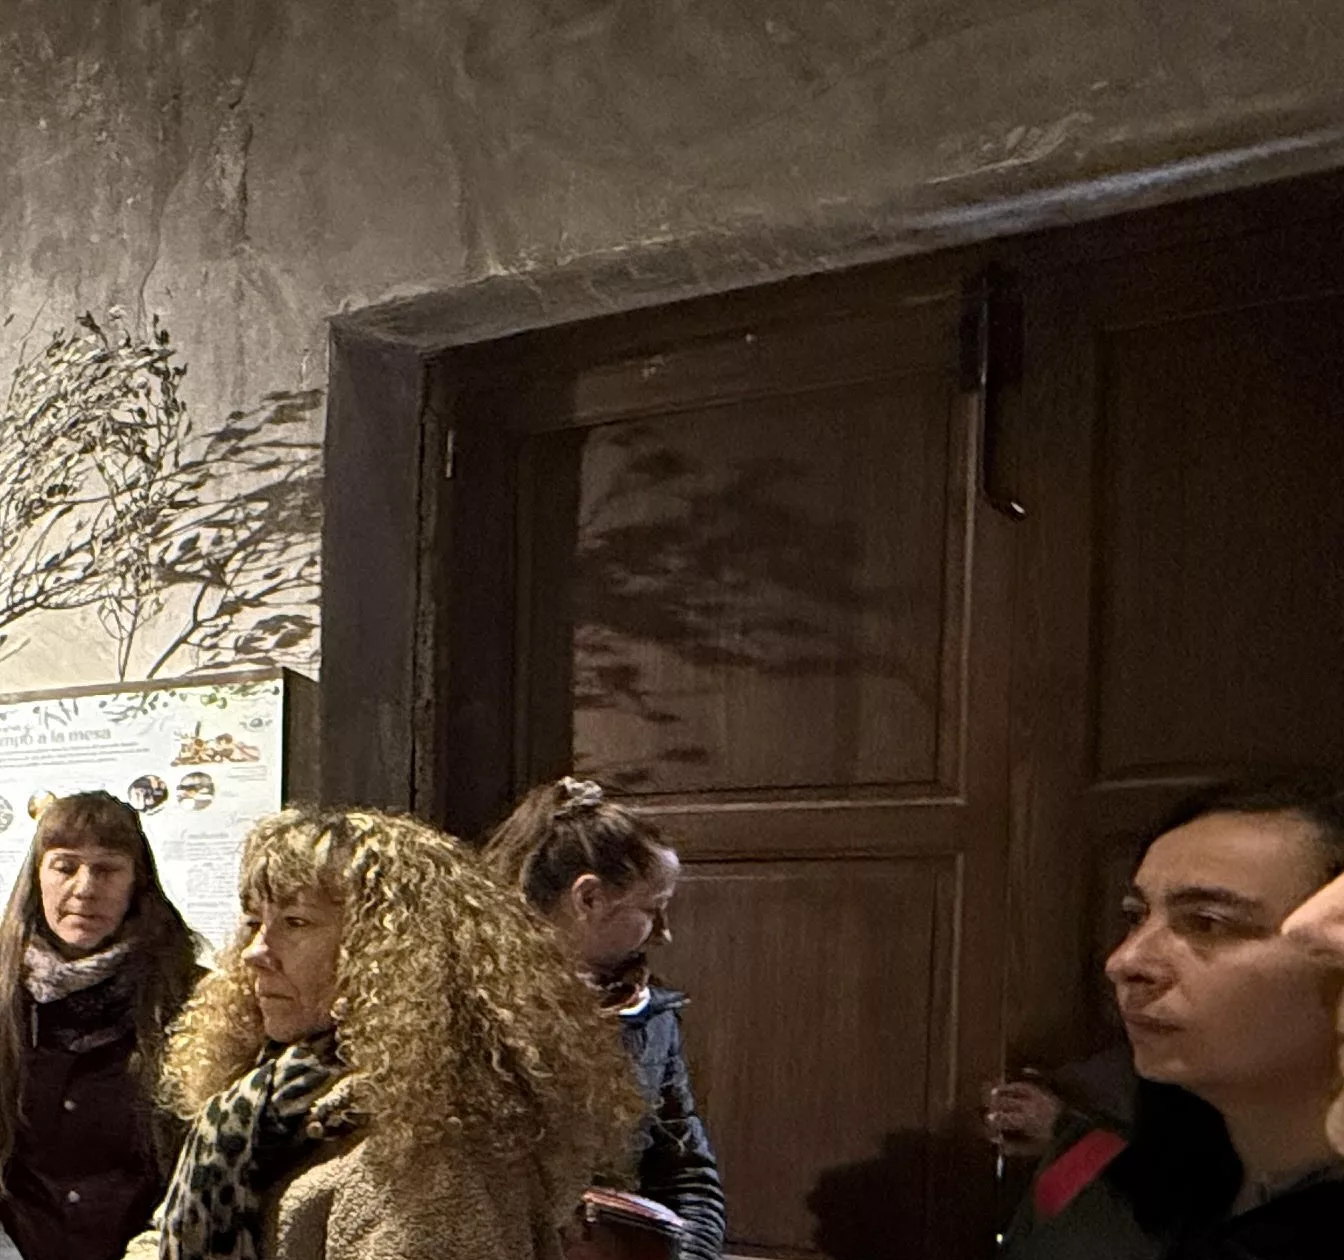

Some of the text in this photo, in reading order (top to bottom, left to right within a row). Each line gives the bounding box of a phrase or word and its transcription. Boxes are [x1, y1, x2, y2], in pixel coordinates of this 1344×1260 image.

[37, 733, 47, 744] a
[50, 729, 65, 743] la
[68, 728, 112, 742] mesa
